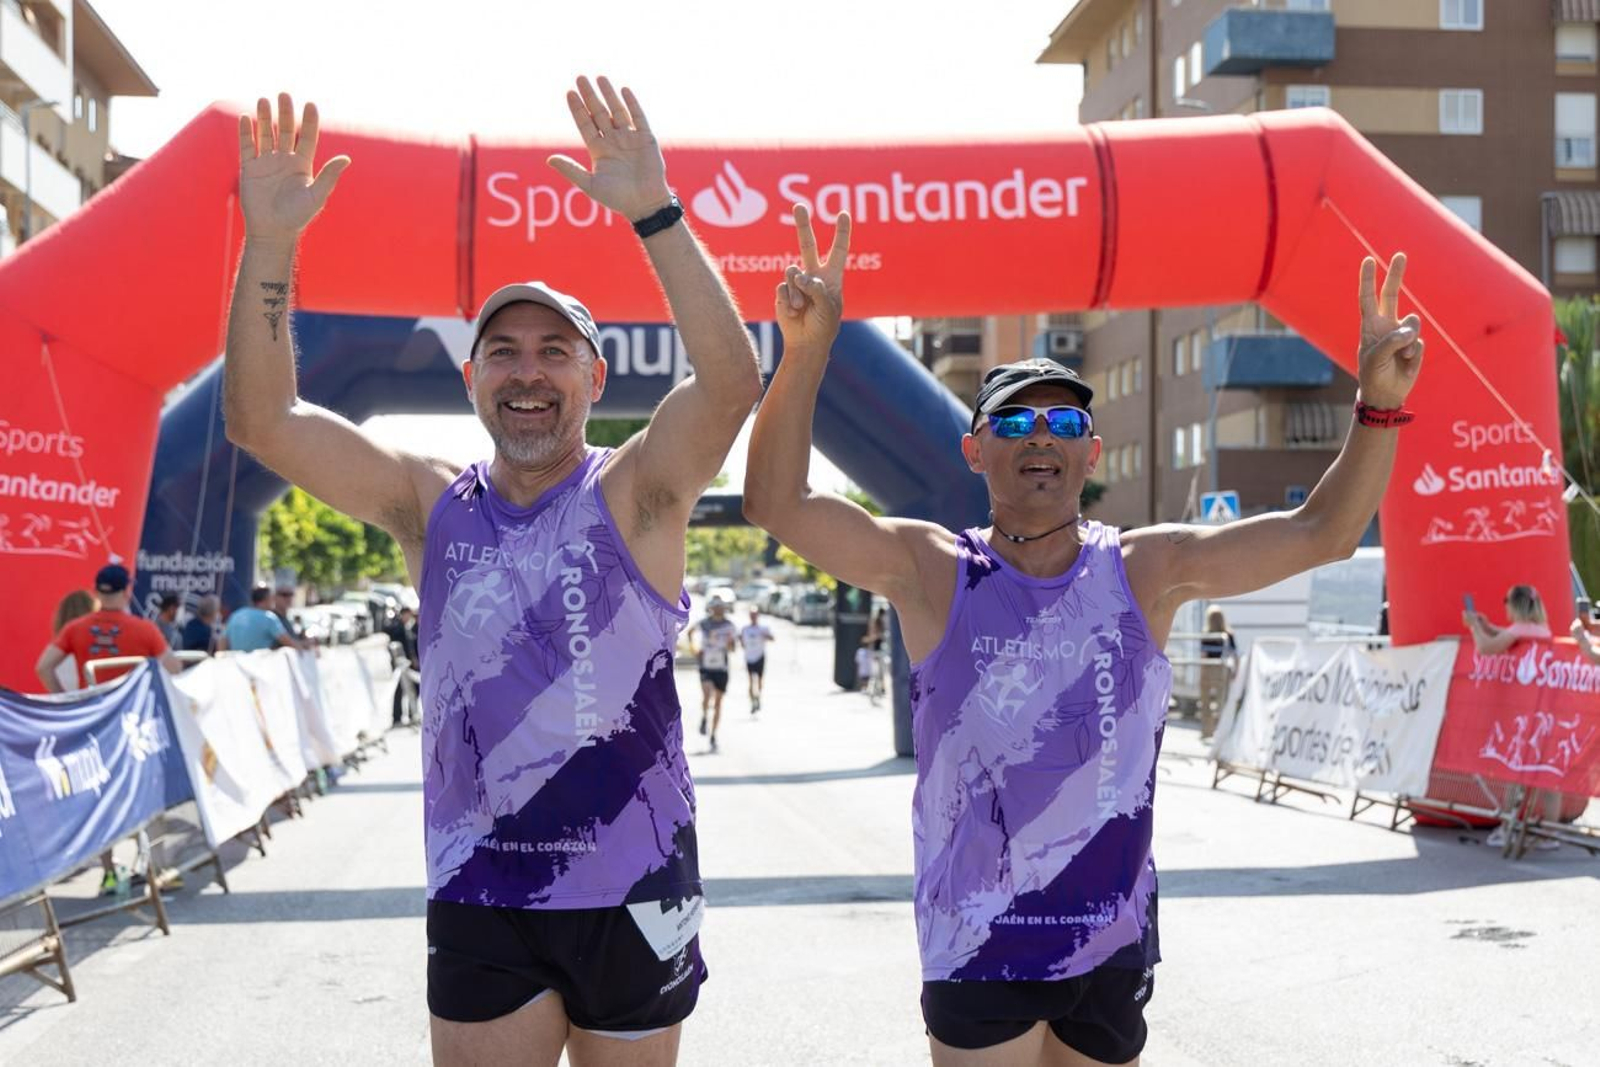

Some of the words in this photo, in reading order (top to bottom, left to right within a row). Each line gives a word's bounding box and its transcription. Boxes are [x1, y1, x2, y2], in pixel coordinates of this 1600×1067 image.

[778, 168, 1088, 225] Santander
[1452, 419, 1536, 452] Sports
[137, 549, 235, 572] fundación
[151, 572, 215, 593] mupol
[971, 635, 1075, 661] ATLETISMO
[502, 841, 518, 851] EN
[520, 842, 535, 853] EL
[537, 839, 597, 852] CORAZÓN
[995, 913, 1025, 925] JAÉN
[1027, 915, 1042, 925] EN
[1044, 915, 1058, 925] EL
